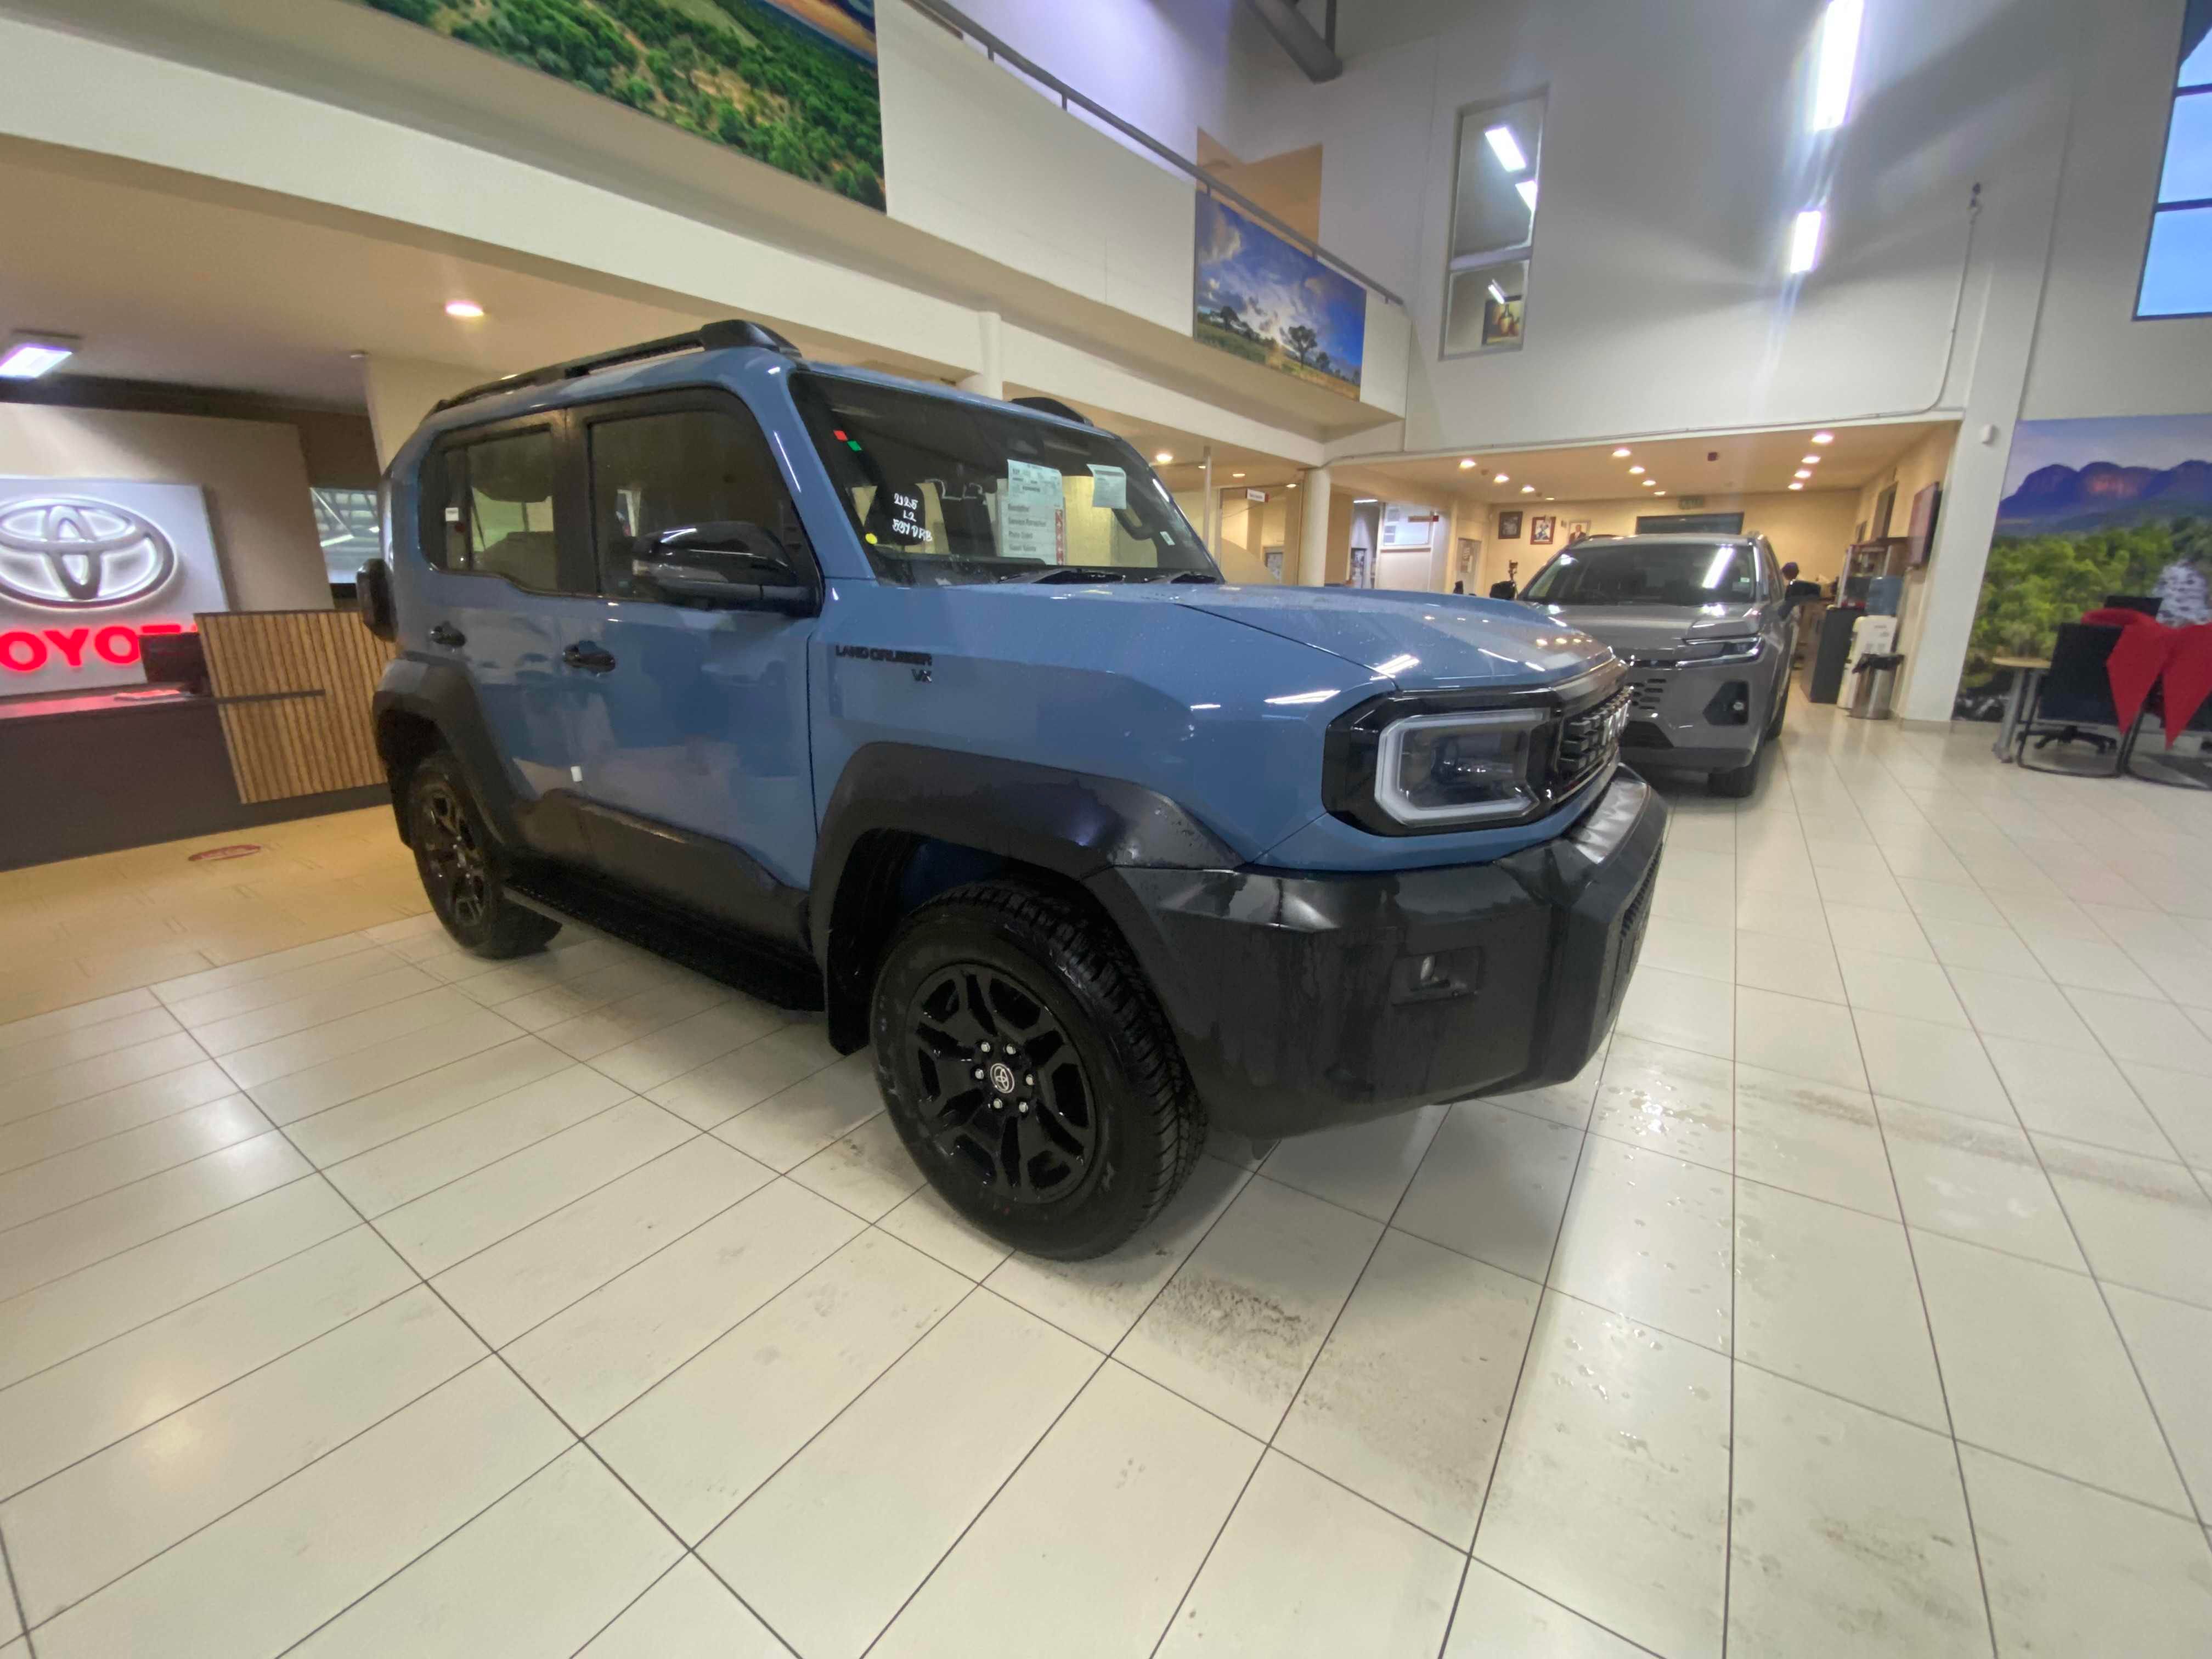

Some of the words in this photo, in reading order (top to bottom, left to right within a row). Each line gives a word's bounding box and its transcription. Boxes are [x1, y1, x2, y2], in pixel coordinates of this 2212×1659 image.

[836, 644, 870, 659] LAND
[870, 647, 932, 666] CRUISER
[911, 668, 932, 683] VX
